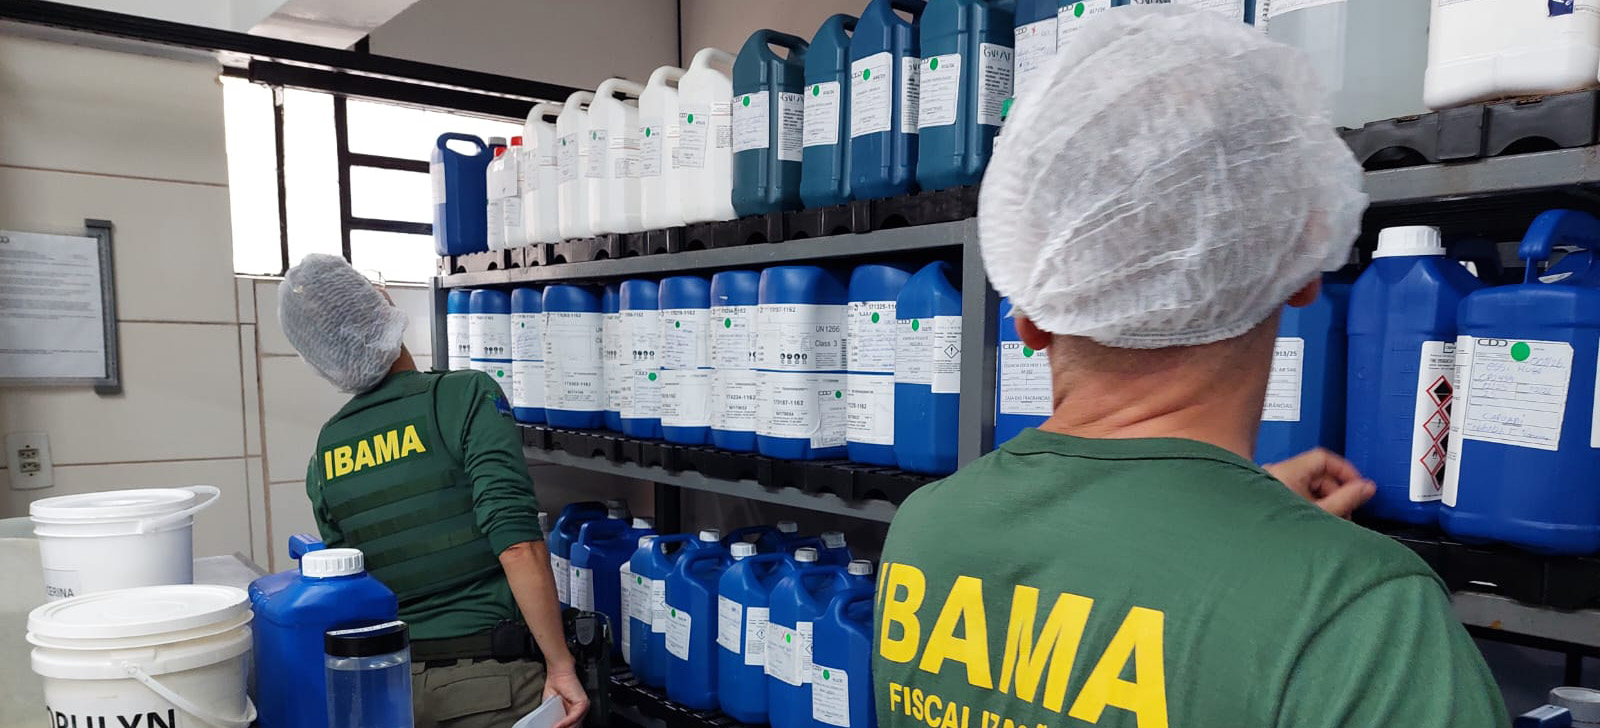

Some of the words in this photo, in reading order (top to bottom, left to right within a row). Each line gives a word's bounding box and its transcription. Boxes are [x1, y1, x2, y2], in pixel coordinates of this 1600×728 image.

[814, 339, 831, 347] Class
[832, 339, 838, 347] 3
[324, 424, 427, 480] IBAMA
